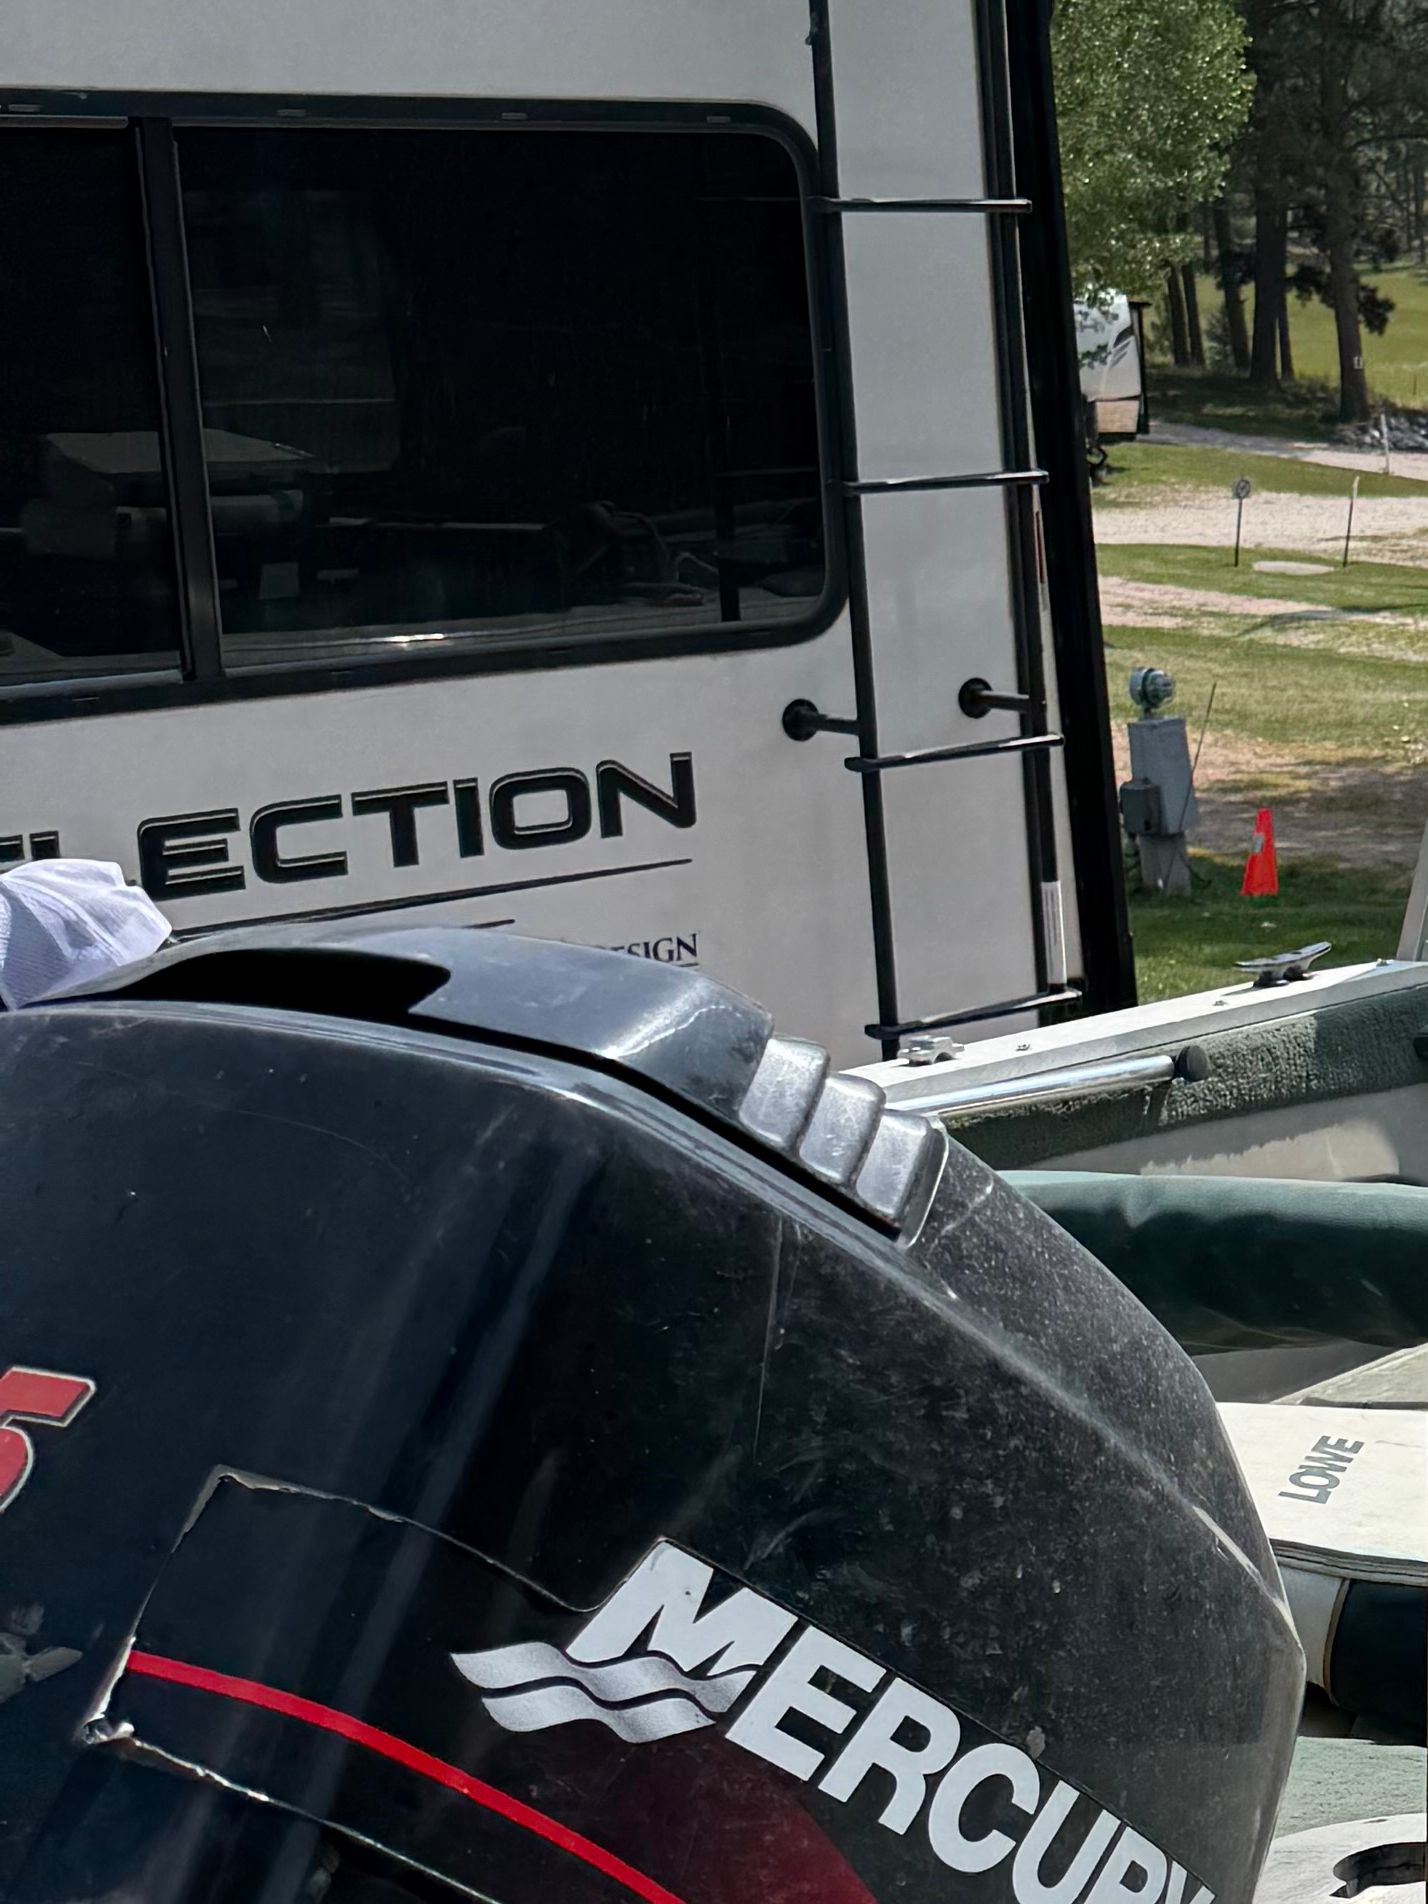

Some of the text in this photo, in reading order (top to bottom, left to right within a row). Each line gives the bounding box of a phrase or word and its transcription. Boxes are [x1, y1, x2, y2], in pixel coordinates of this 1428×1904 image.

[0, 751, 697, 902] ECTION
[597, 932, 698, 963] SIGN
[1278, 1435, 1365, 1504] LOWE
